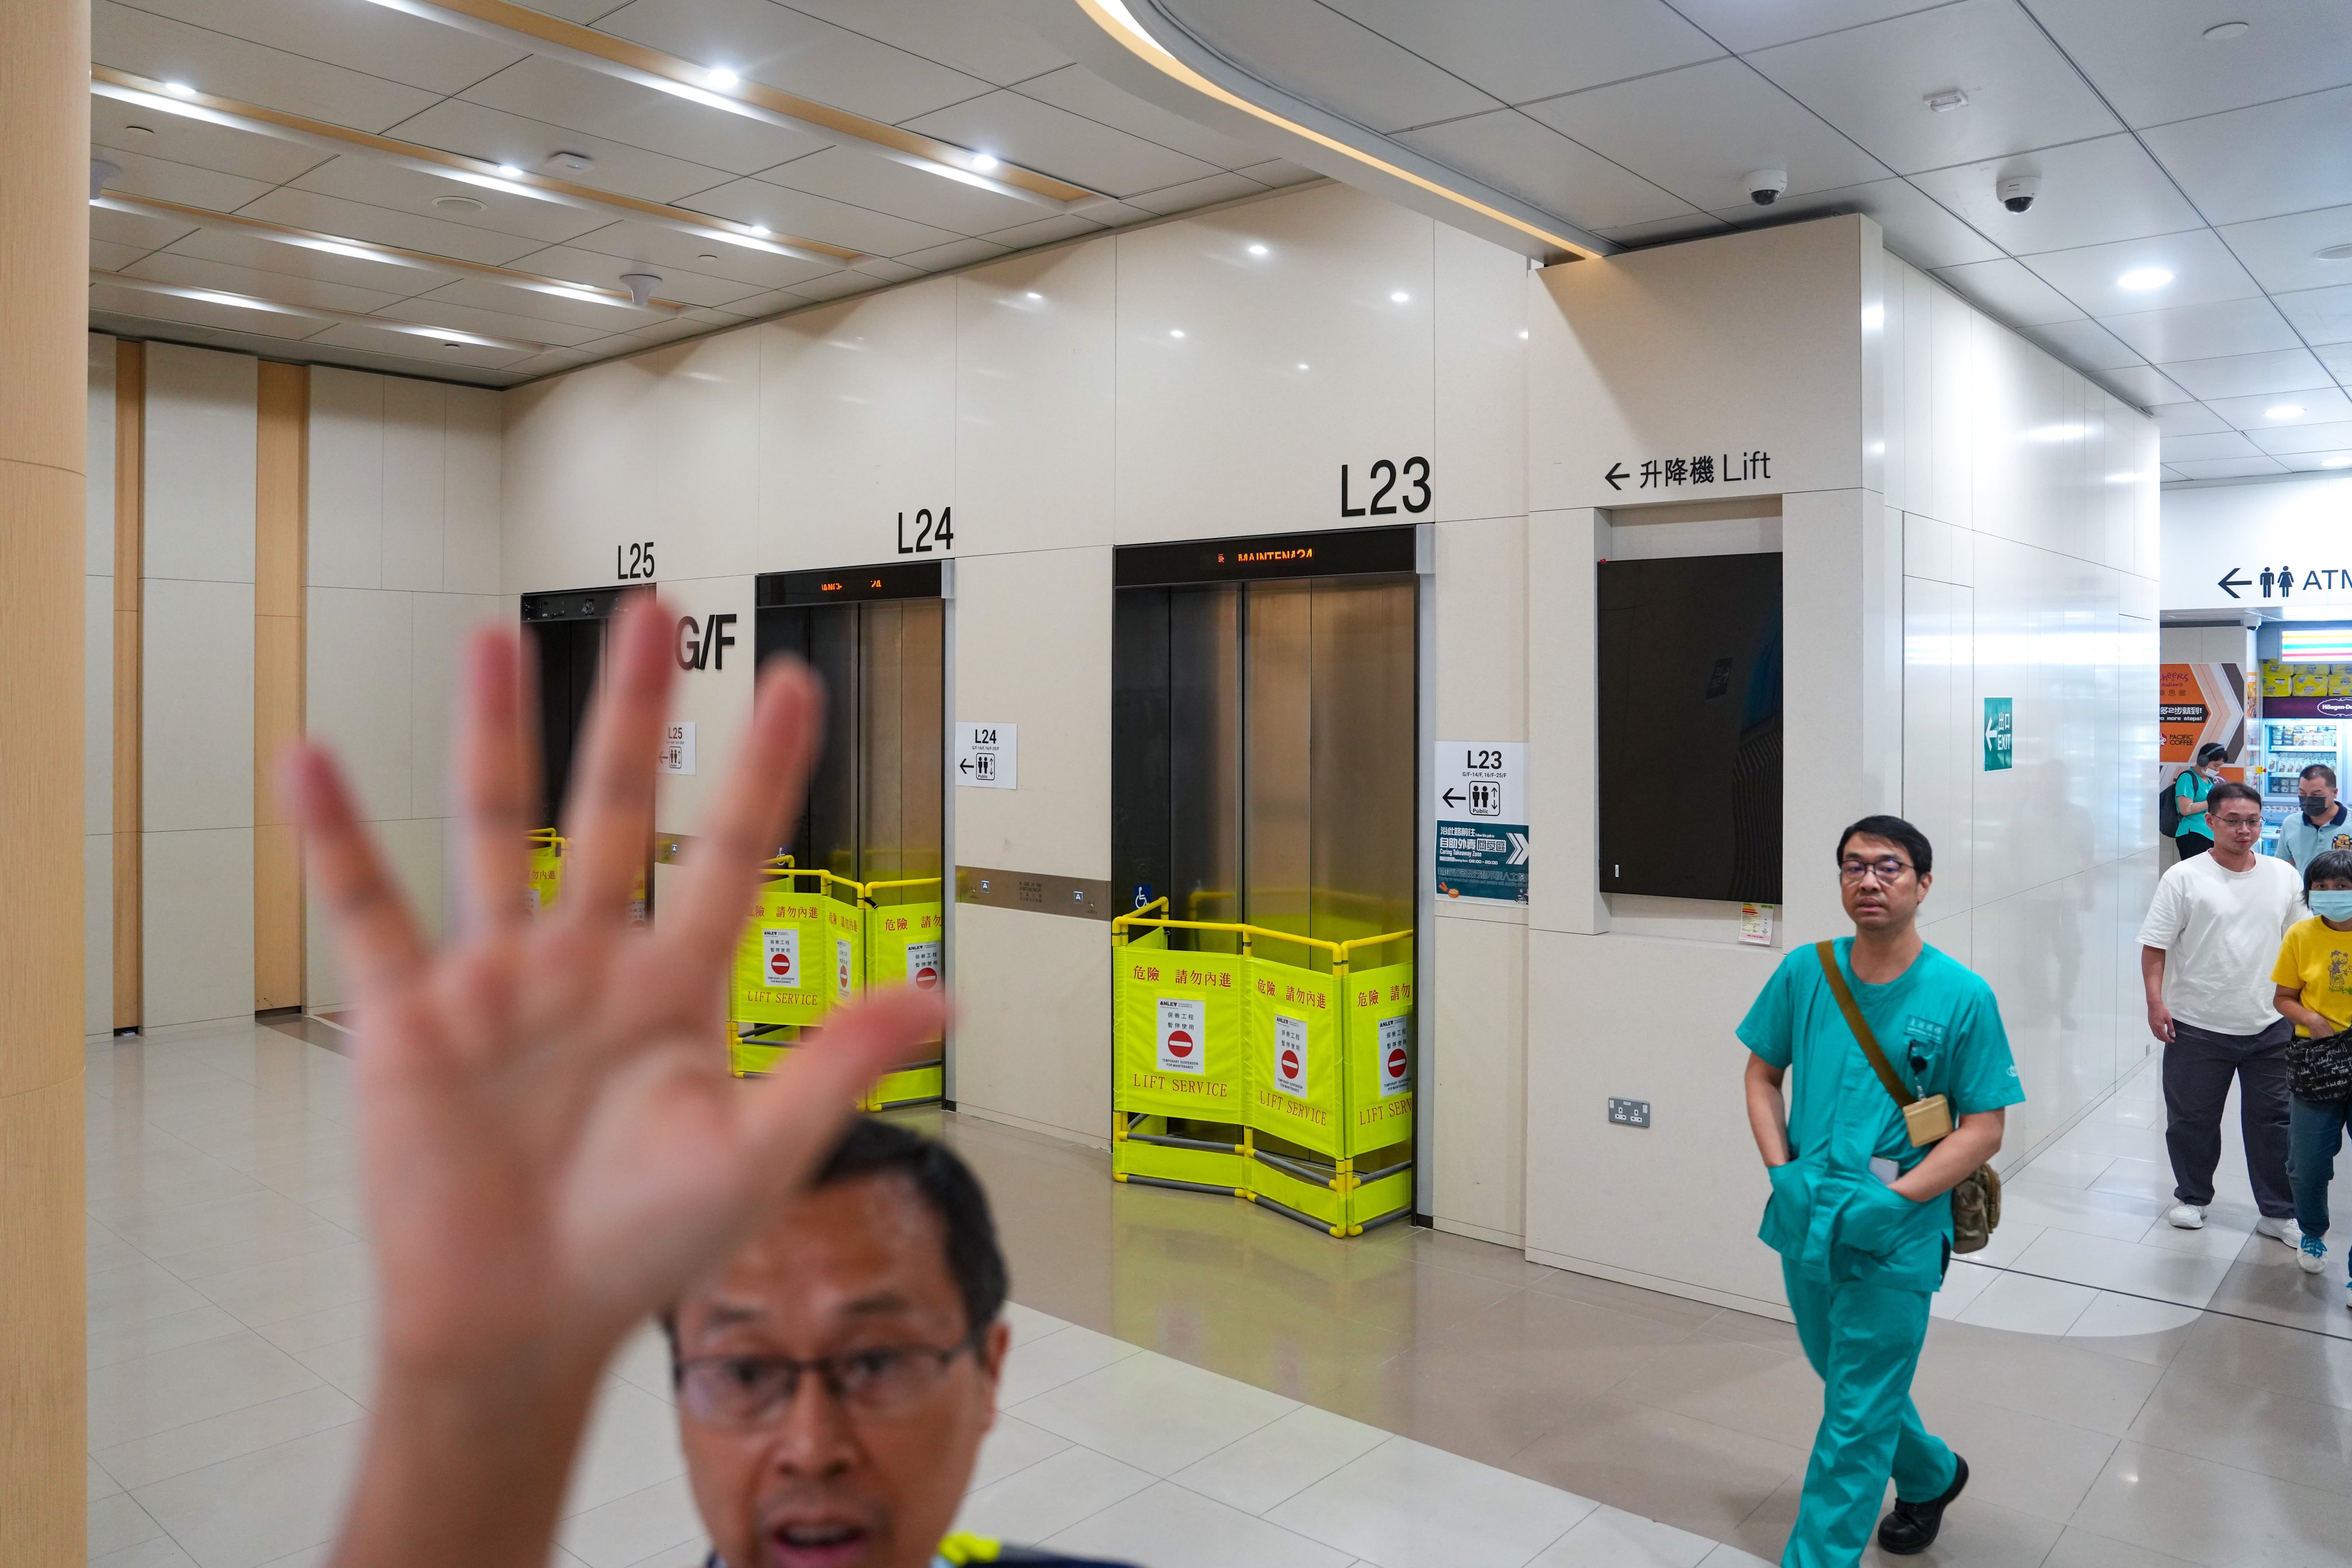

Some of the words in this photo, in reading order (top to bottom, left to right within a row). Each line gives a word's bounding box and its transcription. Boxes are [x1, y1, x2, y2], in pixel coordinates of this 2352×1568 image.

[1640, 455, 1714, 489] 升降機
[1724, 451, 1771, 481] Lift
[1342, 456, 1431, 517] L23
[898, 507, 953, 554] L24
[618, 542, 655, 580] L25
[675, 613, 737, 670] G/F
[1999, 712, 2010, 731] 出口
[669, 727, 682, 739] L25
[975, 729, 997, 744] L24
[1998, 733, 2011, 750] EXIT
[1467, 750, 1502, 769] L23
[1440, 827, 1476, 837] 沿此路前往
[1440, 837, 1476, 849] 自助外賣
[1453, 849, 1472, 858] Takeaway
[528, 870, 556, 880] 勿內進
[777, 906, 818, 918] 請勿內進
[885, 918, 907, 931] 危險
[921, 914, 942, 928] 請勿
[1134, 965, 1160, 981] 危險
[1175, 969, 1231, 987] 請勿內進
[748, 991, 771, 1002] LIFT
[775, 992, 818, 1005] SERVICE
[1258, 978, 1276, 997] 危險
[1286, 986, 1326, 1009] 請勿內進
[1357, 989, 1379, 1007] 危險
[1391, 983, 1411, 1002] 請勿
[1168, 1012, 1194, 1020] 保養工程
[1168, 1022, 1194, 1030] 暫停使用
[1387, 1028, 1406, 1039] 保養工程
[1281, 1029, 1300, 1040] 保養工程
[1281, 1040, 1300, 1051] 暫停使用
[1387, 1038, 1407, 1049] 暫停使用
[1134, 1074, 1165, 1089] LIFT
[1172, 1079, 1227, 1097] SERVICE
[1285, 1084, 1299, 1092] MAINTENANCE
[1260, 1091, 1283, 1110] LIFT
[1287, 1100, 1327, 1126] SERVICE
[1360, 1106, 1383, 1125] LIFT
[1389, 1098, 1412, 1117] SERV
